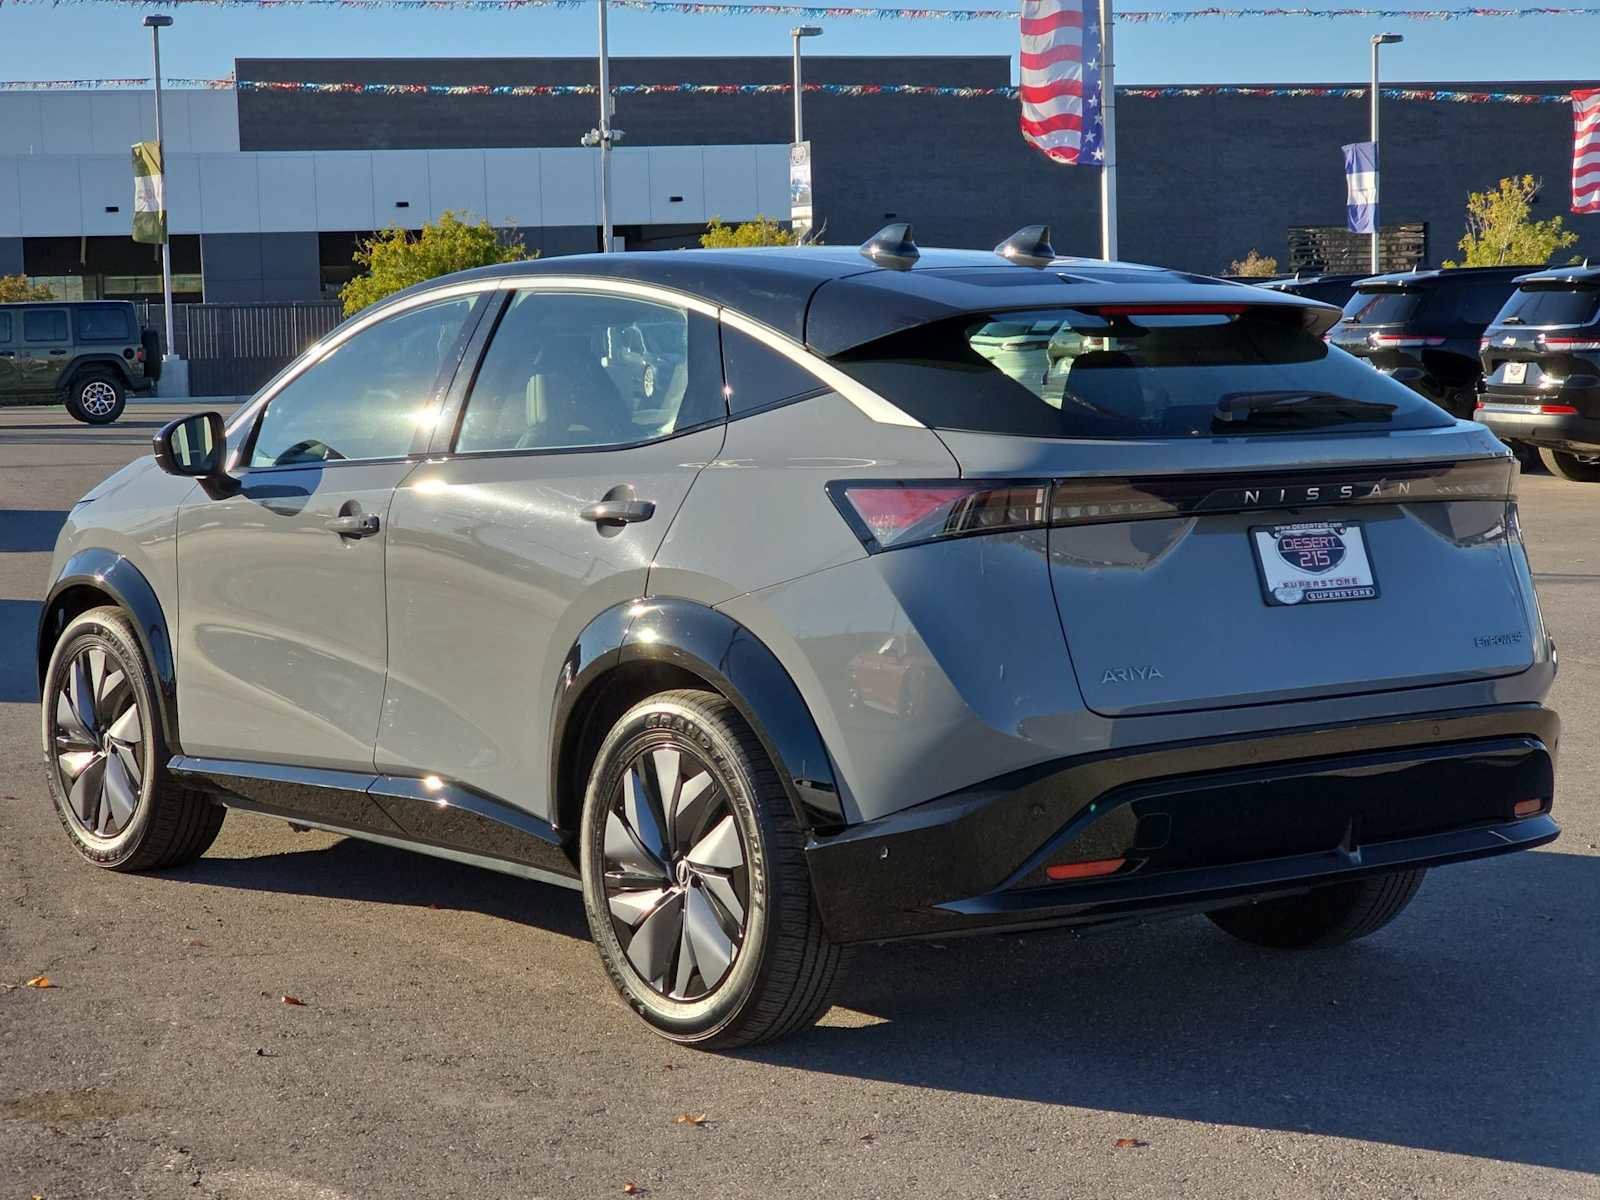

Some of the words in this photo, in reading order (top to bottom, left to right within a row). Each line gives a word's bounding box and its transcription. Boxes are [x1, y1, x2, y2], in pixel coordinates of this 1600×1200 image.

[1244, 482, 1411, 504] NISSAN
[1282, 536, 1337, 550] DESERT
[1298, 550, 1330, 567] 215
[1282, 577, 1359, 588] SUPERSTORE
[1308, 587, 1372, 599] SUPERSTORE
[1101, 666, 1165, 684] ARIYA
